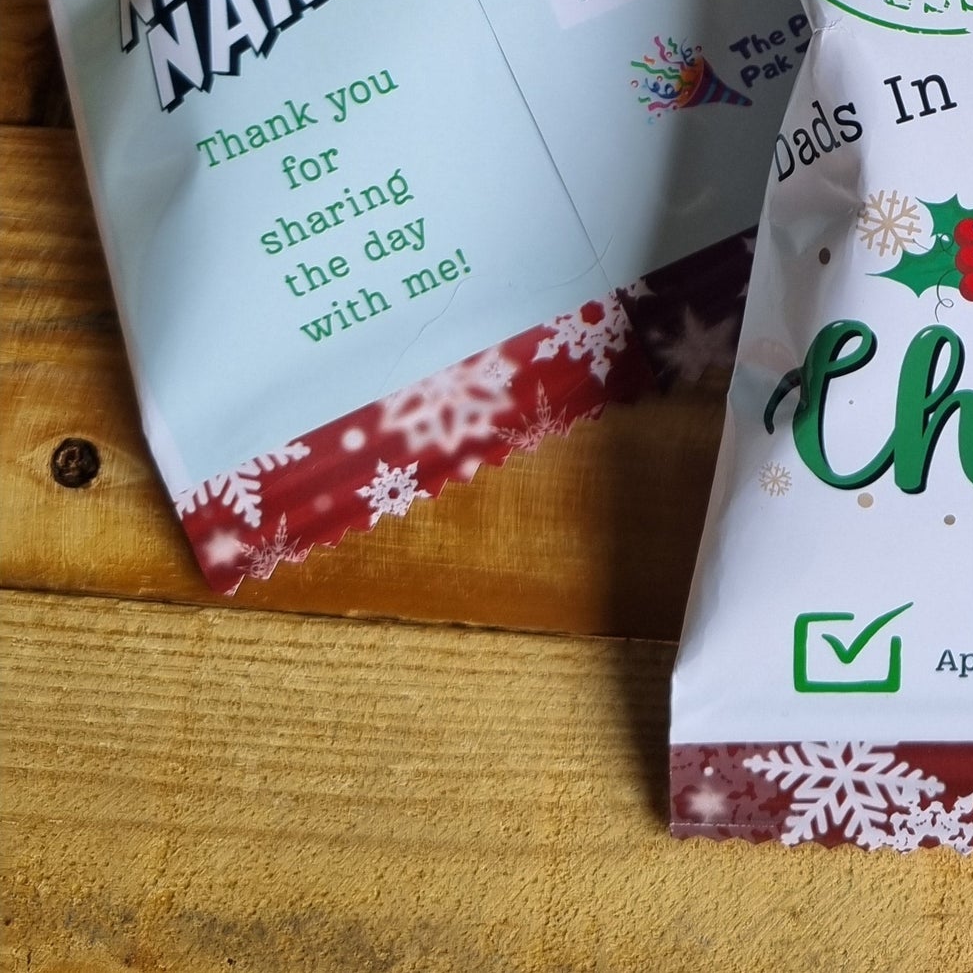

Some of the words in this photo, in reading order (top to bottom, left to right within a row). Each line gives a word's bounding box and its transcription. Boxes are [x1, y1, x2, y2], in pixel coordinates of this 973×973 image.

[729, 30, 787, 60] The
[740, 54, 794, 88] Pak
[196, 99, 318, 169] Thank
[324, 68, 400, 125] you
[774, 100, 864, 183] Dads
[884, 73, 957, 125] In
[281, 145, 341, 191] for
[259, 168, 415, 257] sharing
[284, 254, 351, 298] the
[363, 216, 427, 263] day
[300, 287, 391, 345] with
[401, 249, 473, 300] me!
